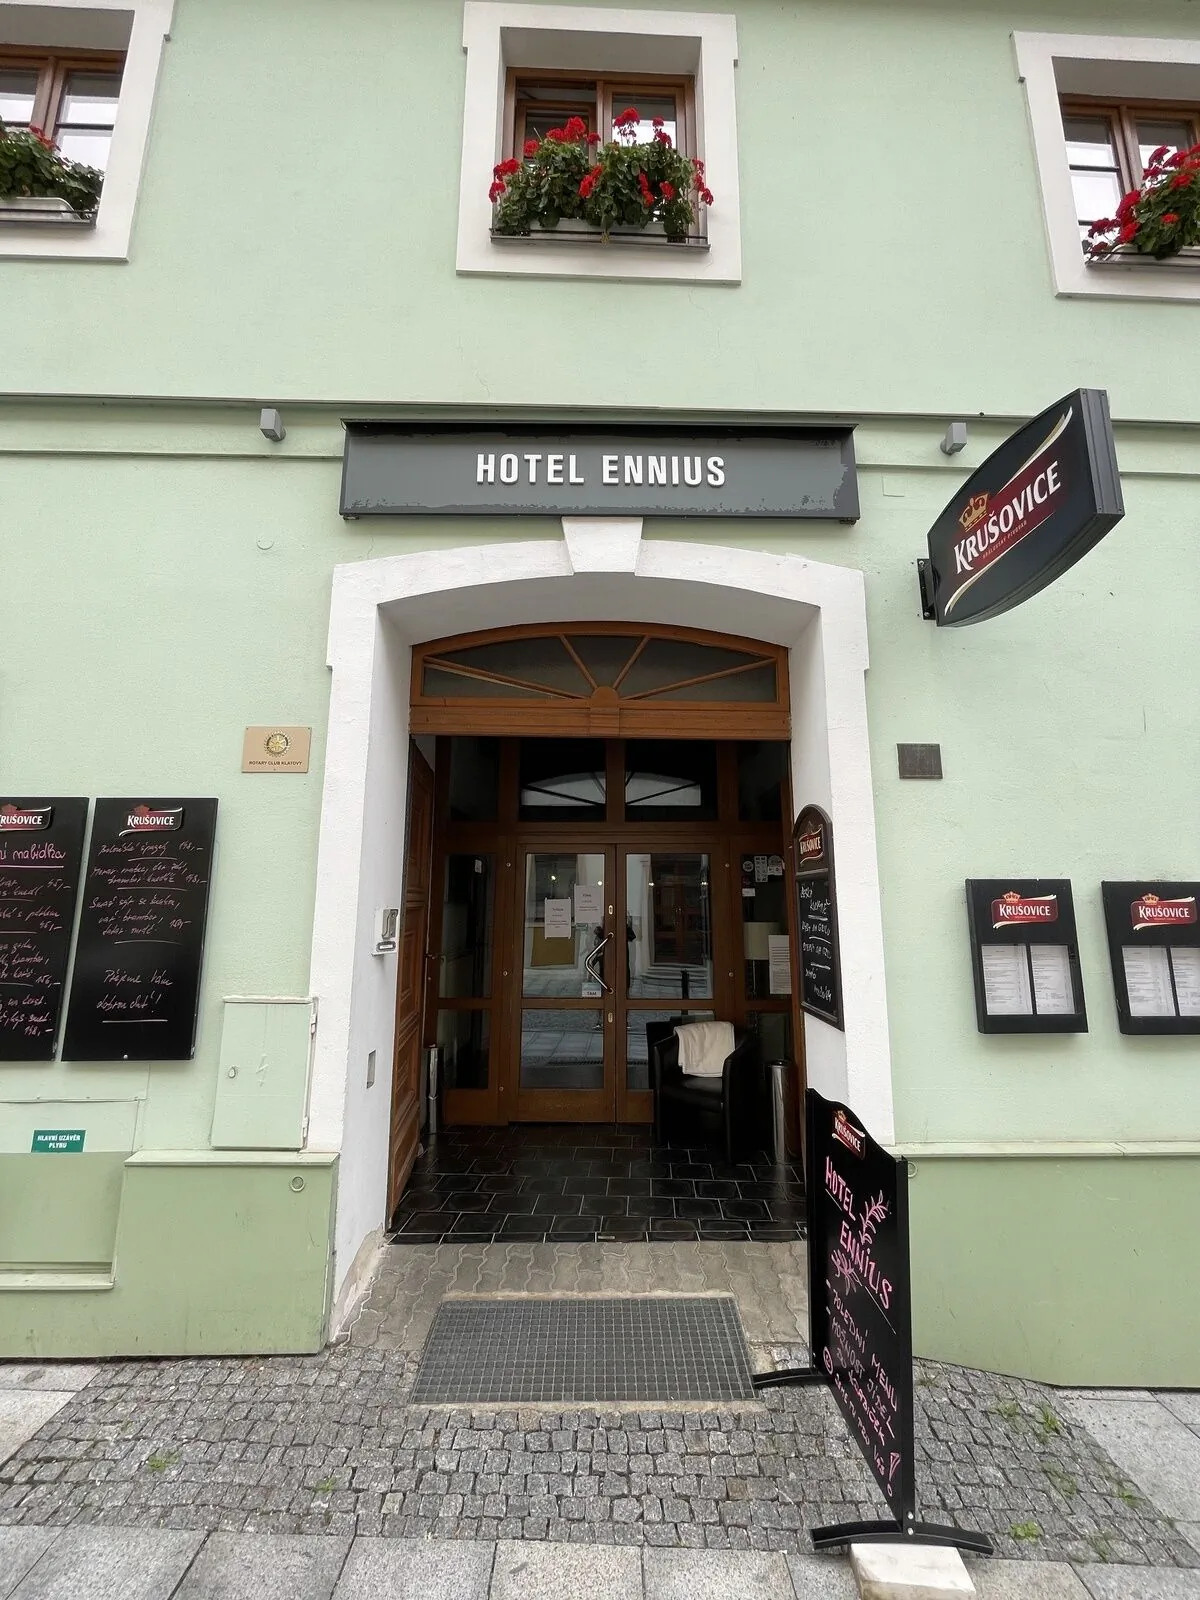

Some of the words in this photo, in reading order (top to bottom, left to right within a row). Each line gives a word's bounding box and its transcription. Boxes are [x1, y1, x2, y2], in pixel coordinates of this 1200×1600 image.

[476, 453, 585, 485] HOTEL
[602, 454, 726, 488] ENNIUS
[953, 460, 1061, 575] KRUŠOVICE
[0, 813, 43, 827] RUŠOVICE
[127, 815, 175, 828] KRUŠOVICE
[12, 842, 66, 860] nabídka
[999, 903, 1051, 919] KRUŠOVICE
[1138, 905, 1190, 921] KRUŠOVICE
[37, 1133, 58, 1141] HLAVNÍ
[825, 1155, 857, 1222] HOTEL
[839, 1219, 893, 1310] ENNIUS
[871, 1353, 898, 1412] MENU
